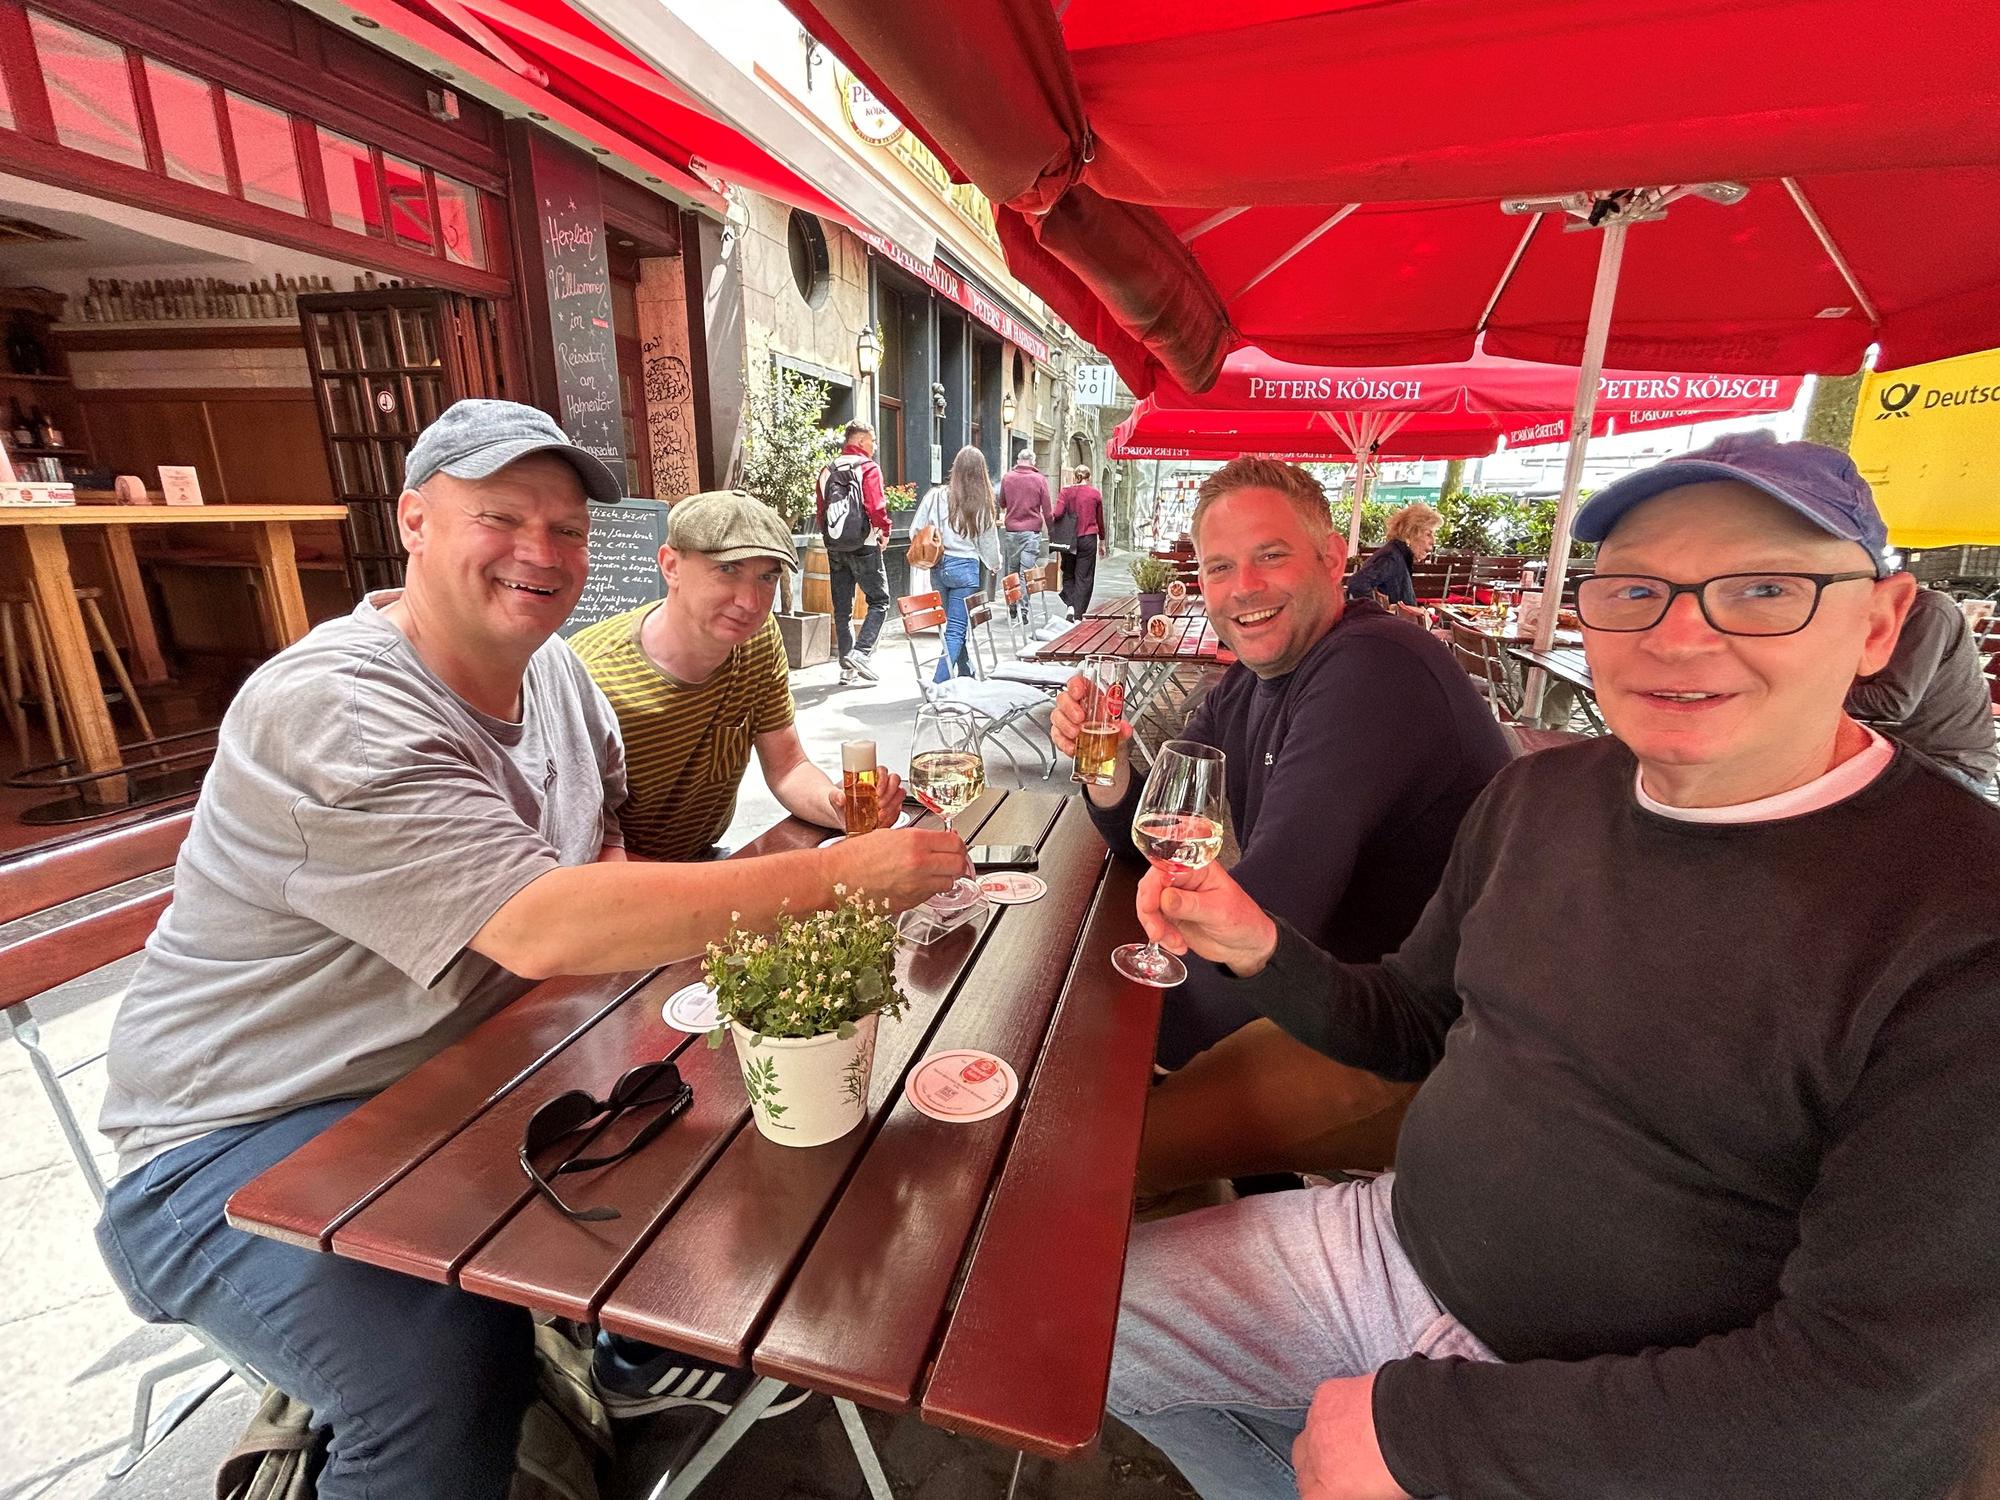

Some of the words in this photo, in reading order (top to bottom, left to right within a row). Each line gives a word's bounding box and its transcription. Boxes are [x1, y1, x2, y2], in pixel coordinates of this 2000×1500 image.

[548, 215, 597, 261] Herzlich
[549, 264, 607, 319] Willkommen
[569, 312, 585, 331] im
[558, 342, 607, 379] Reissdorf
[580, 376, 596, 390] am
[1249, 377, 1332, 400] PETERS
[1336, 377, 1423, 400] KÖLSCH
[1684, 375, 1779, 399] KÖLSCH
[566, 391, 615, 428] Hahnentor
